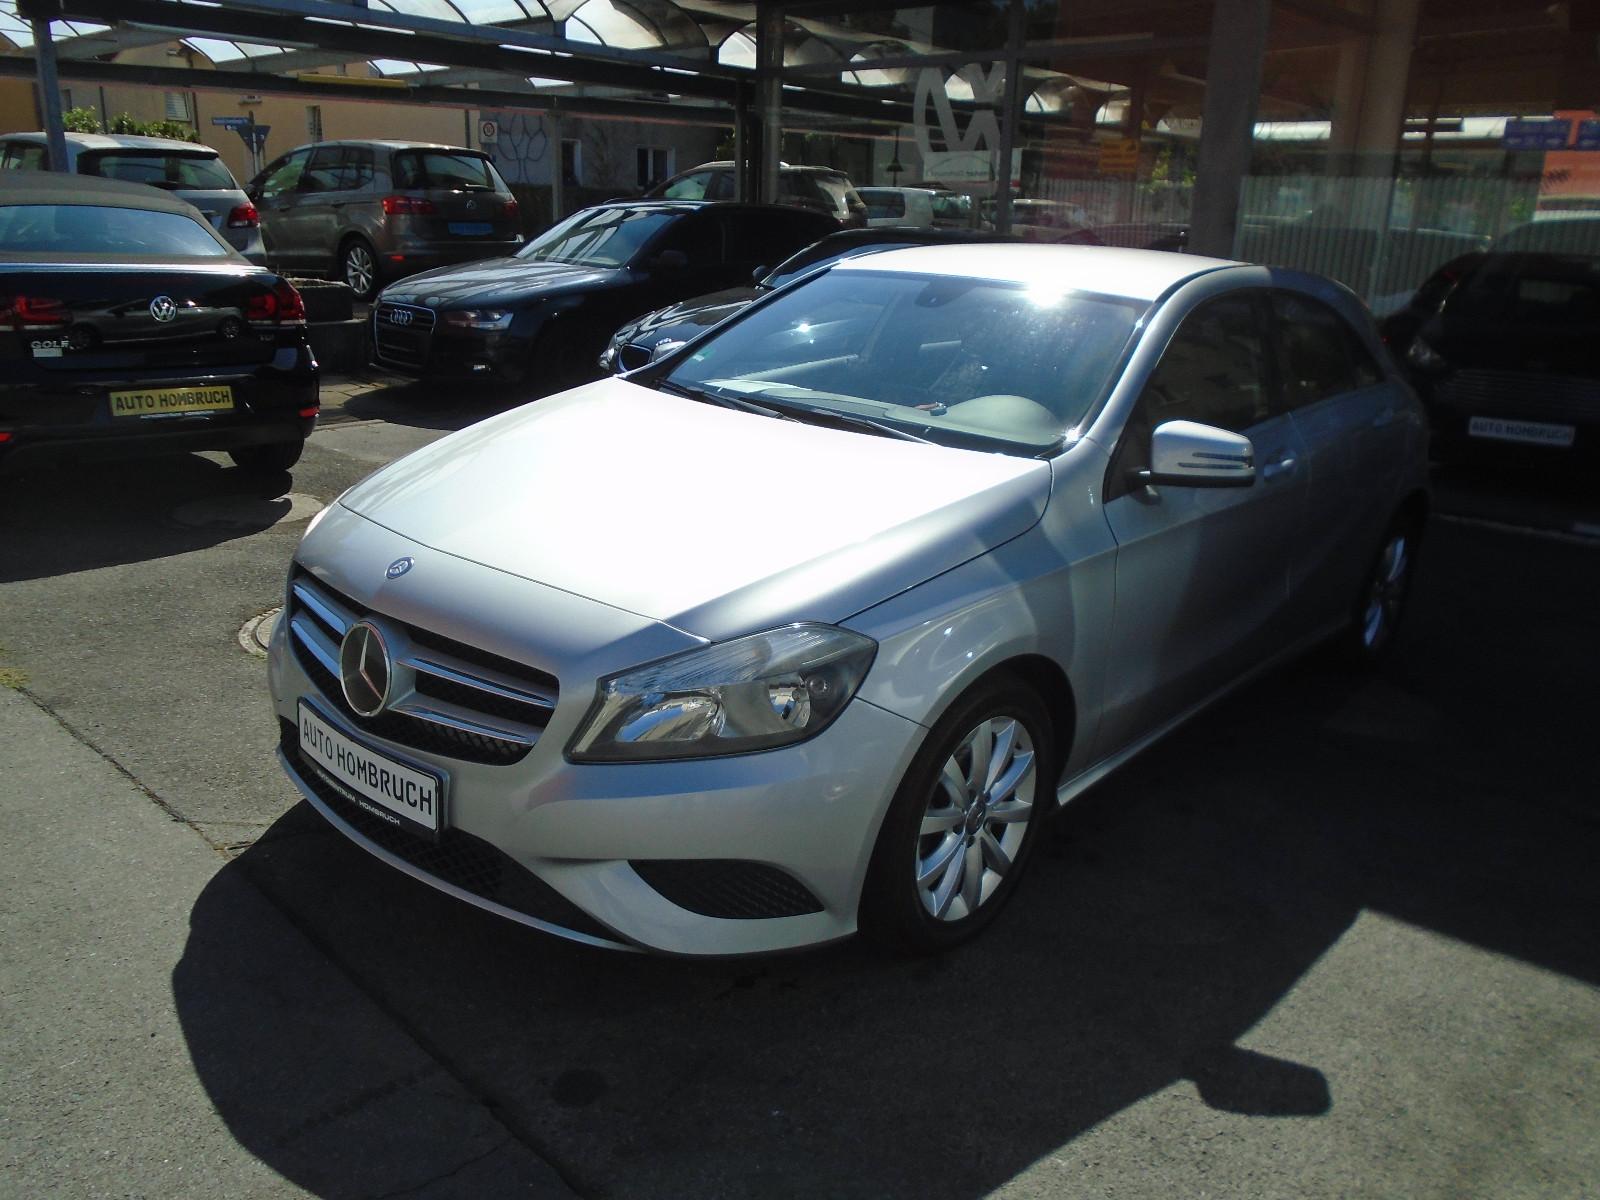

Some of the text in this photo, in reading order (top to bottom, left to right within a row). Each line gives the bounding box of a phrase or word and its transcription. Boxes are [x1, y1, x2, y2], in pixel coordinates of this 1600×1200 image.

[31, 340, 70, 349] GOLF
[115, 390, 231, 411] AUTO HOMBRUCH
[1471, 421, 1503, 434] AUTO
[303, 717, 333, 760] AUTO
[337, 743, 433, 816] HOMBRUCH
[359, 799, 401, 826] HOMBRUCH
